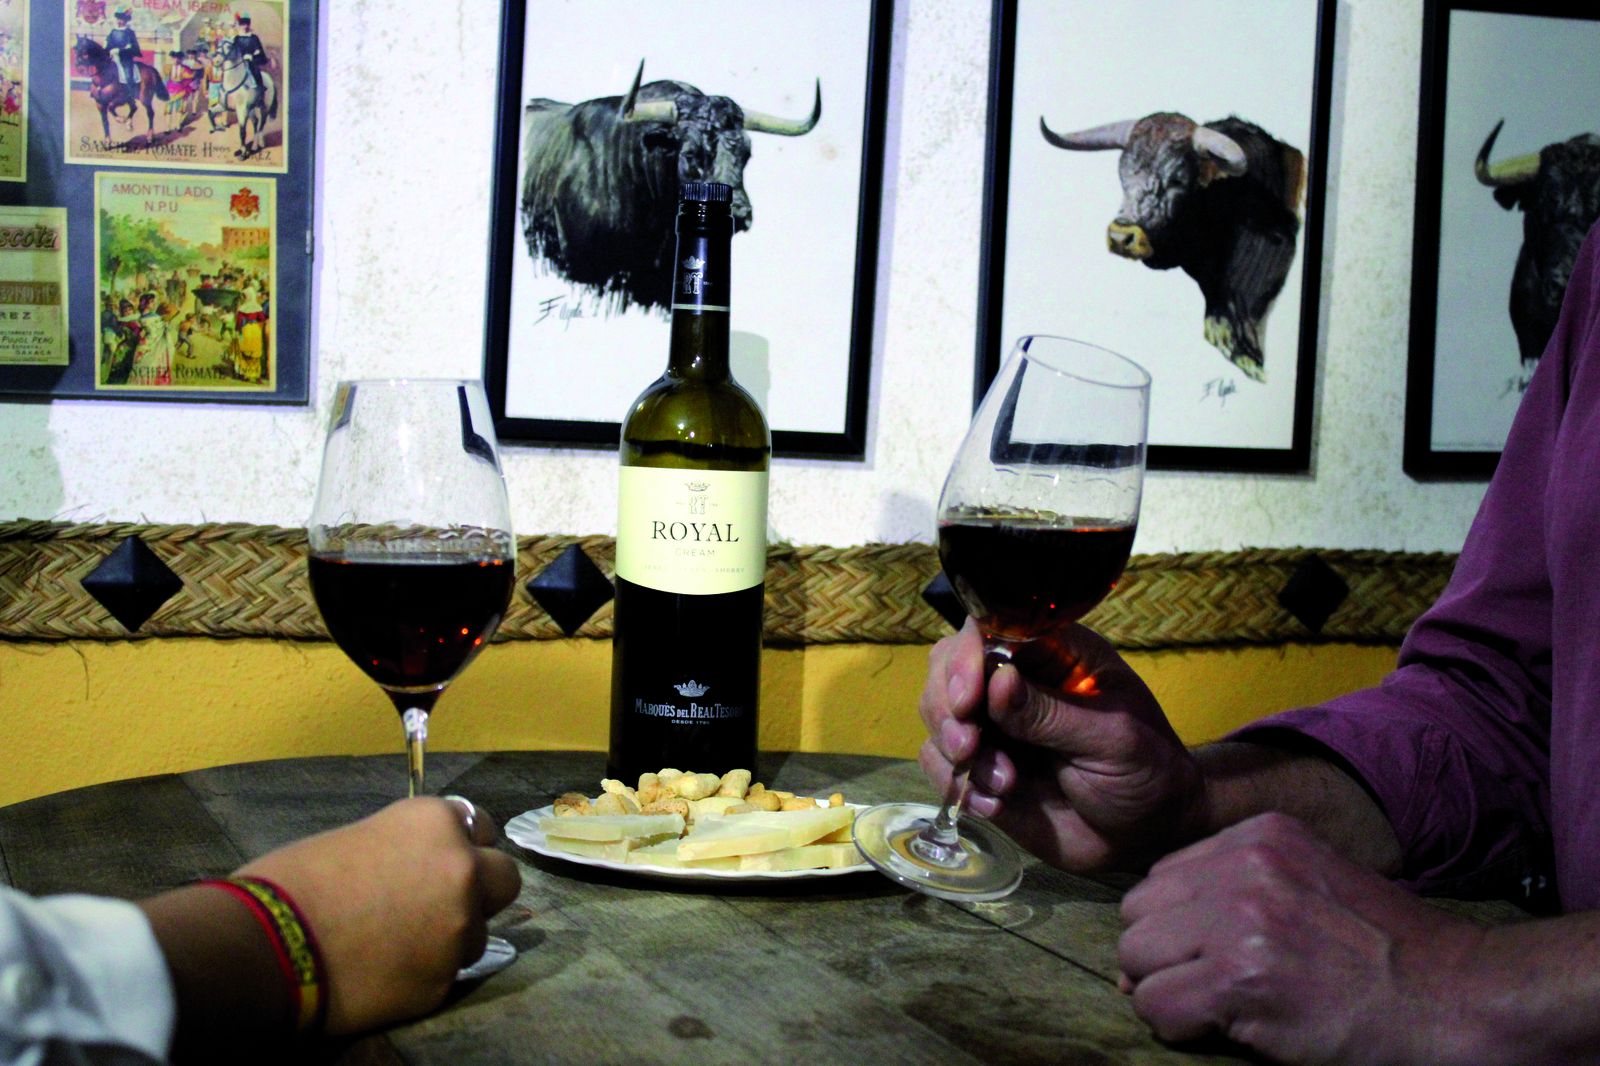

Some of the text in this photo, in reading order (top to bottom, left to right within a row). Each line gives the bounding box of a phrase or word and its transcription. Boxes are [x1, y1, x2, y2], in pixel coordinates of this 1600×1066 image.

[111, 183, 214, 198] AMONTILLADO
[651, 520, 740, 543] ROYAL
[675, 547, 716, 557] CREAM
